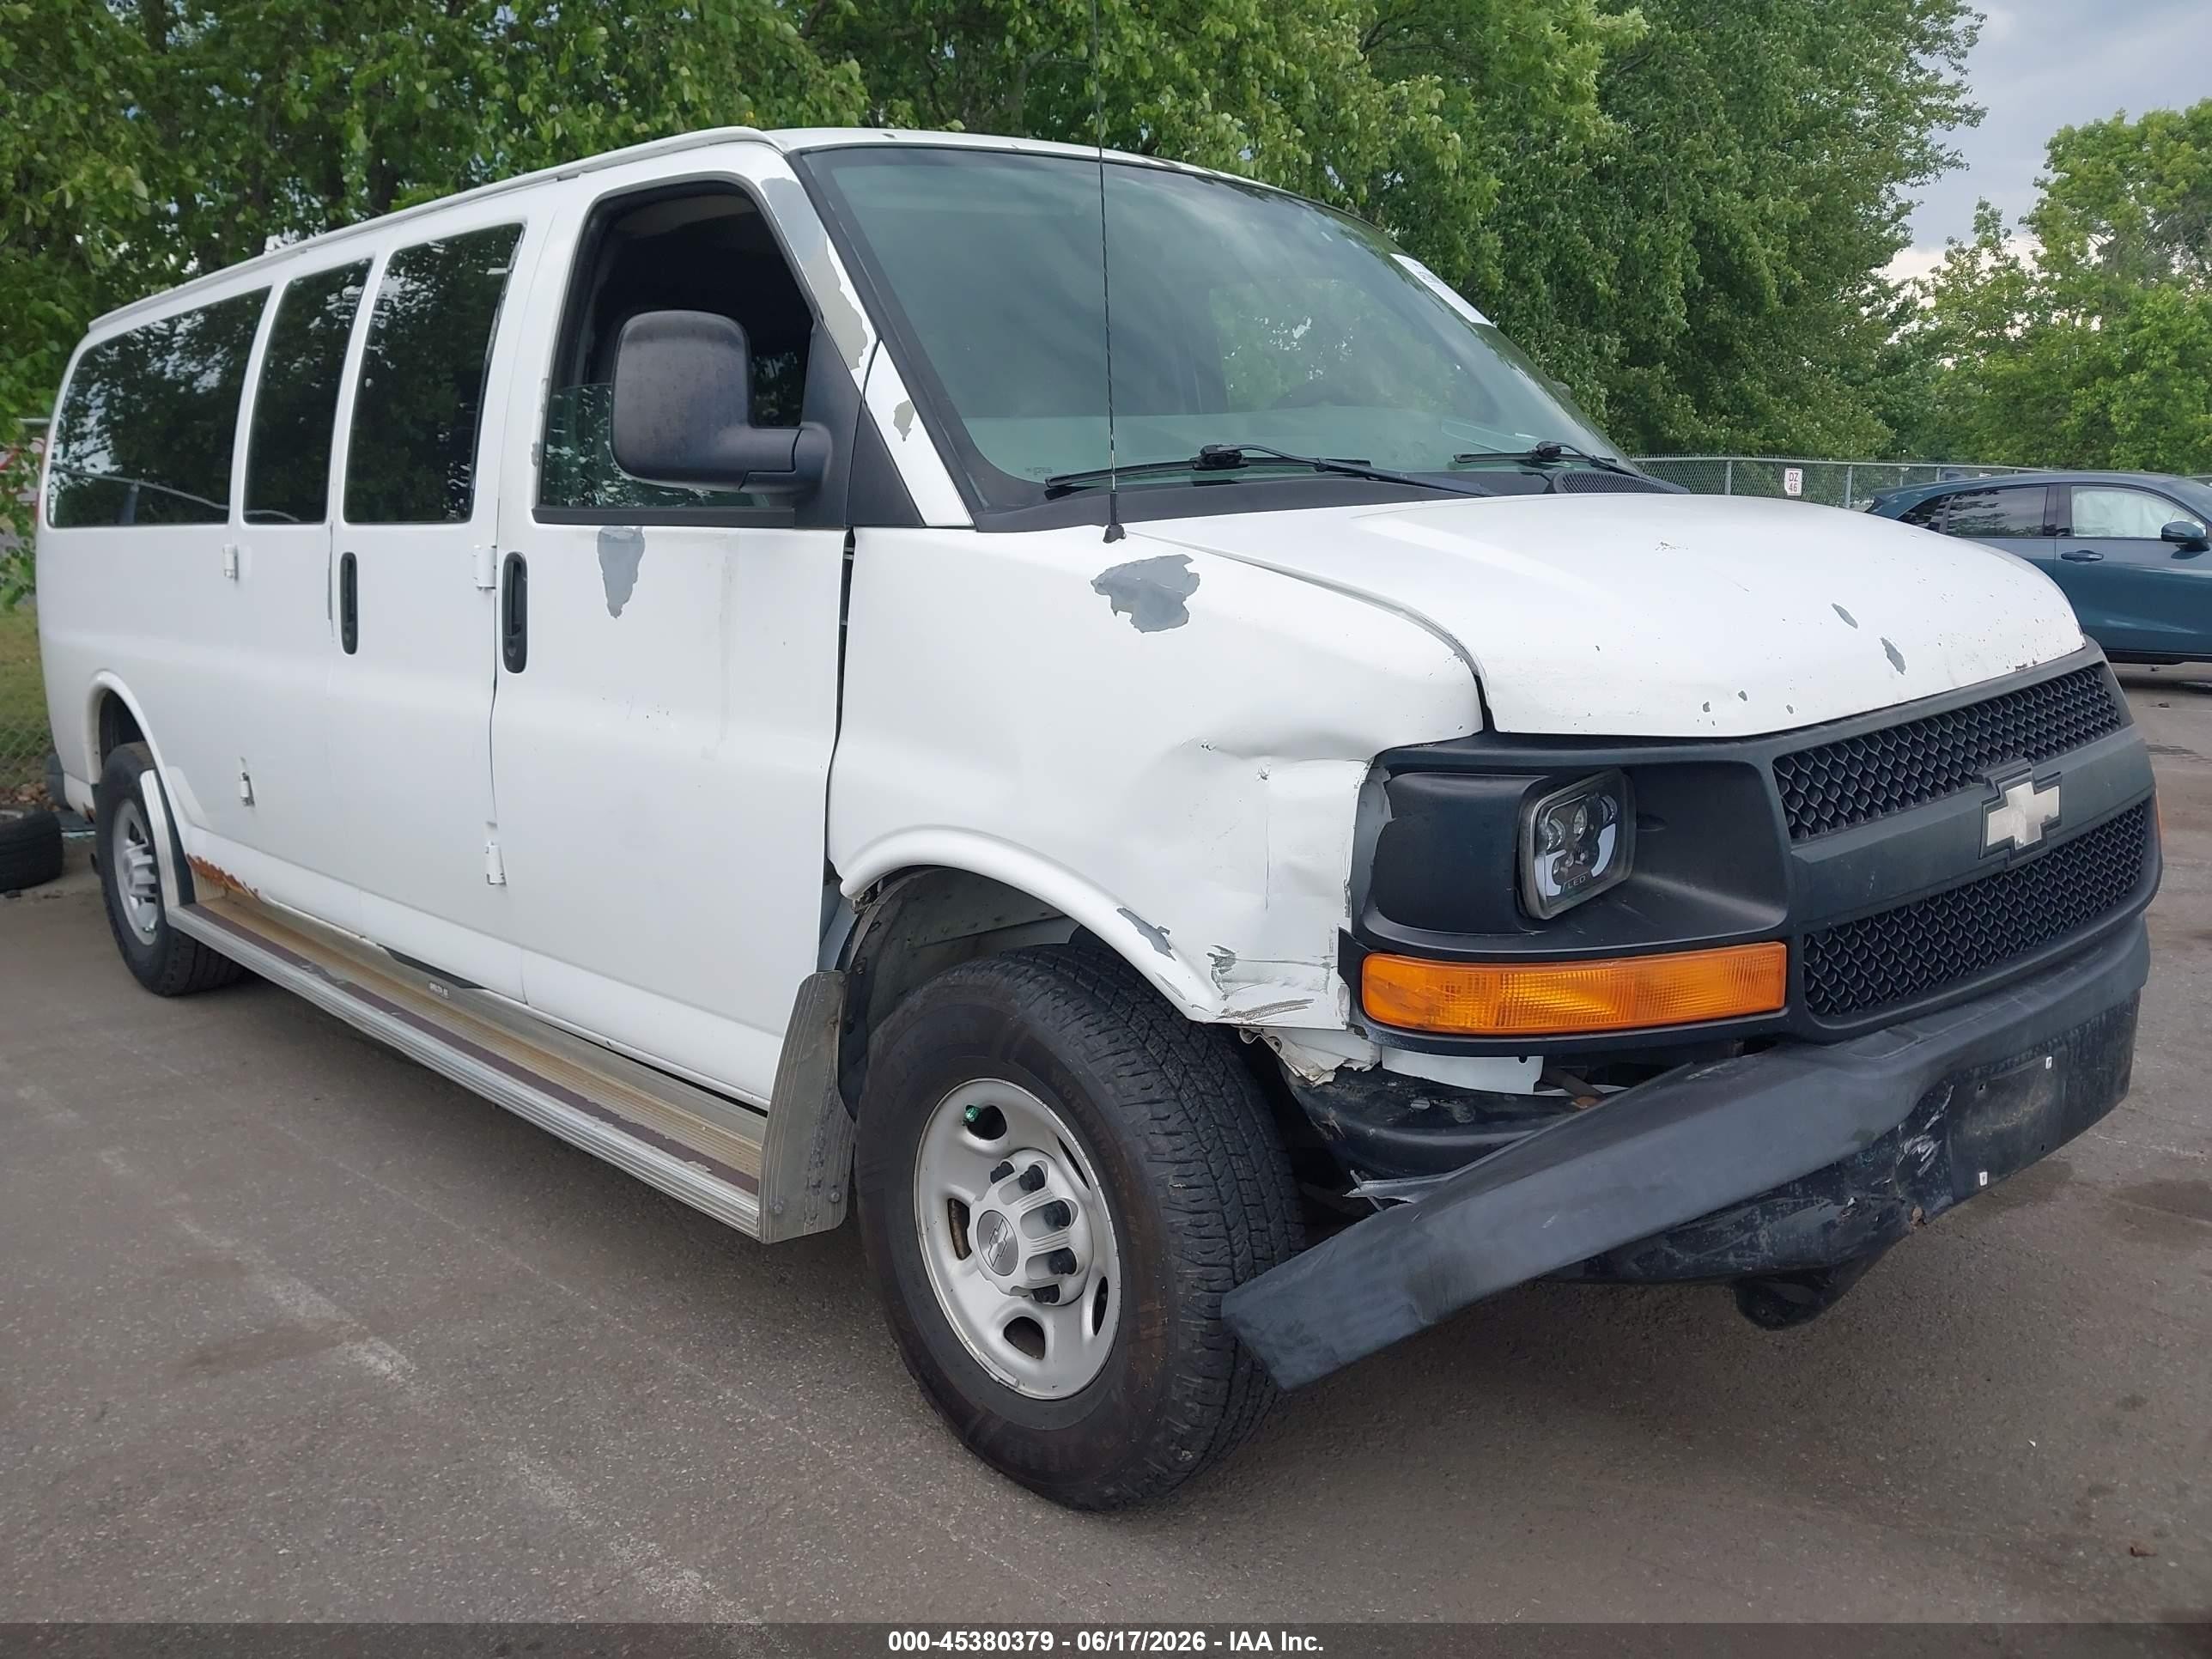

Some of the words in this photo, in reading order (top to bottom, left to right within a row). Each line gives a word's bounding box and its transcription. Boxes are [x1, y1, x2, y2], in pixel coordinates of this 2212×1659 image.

[1789, 472, 1799, 482] DZ
[1789, 483, 1798, 492] 46
[1567, 875, 1586, 889] LED
